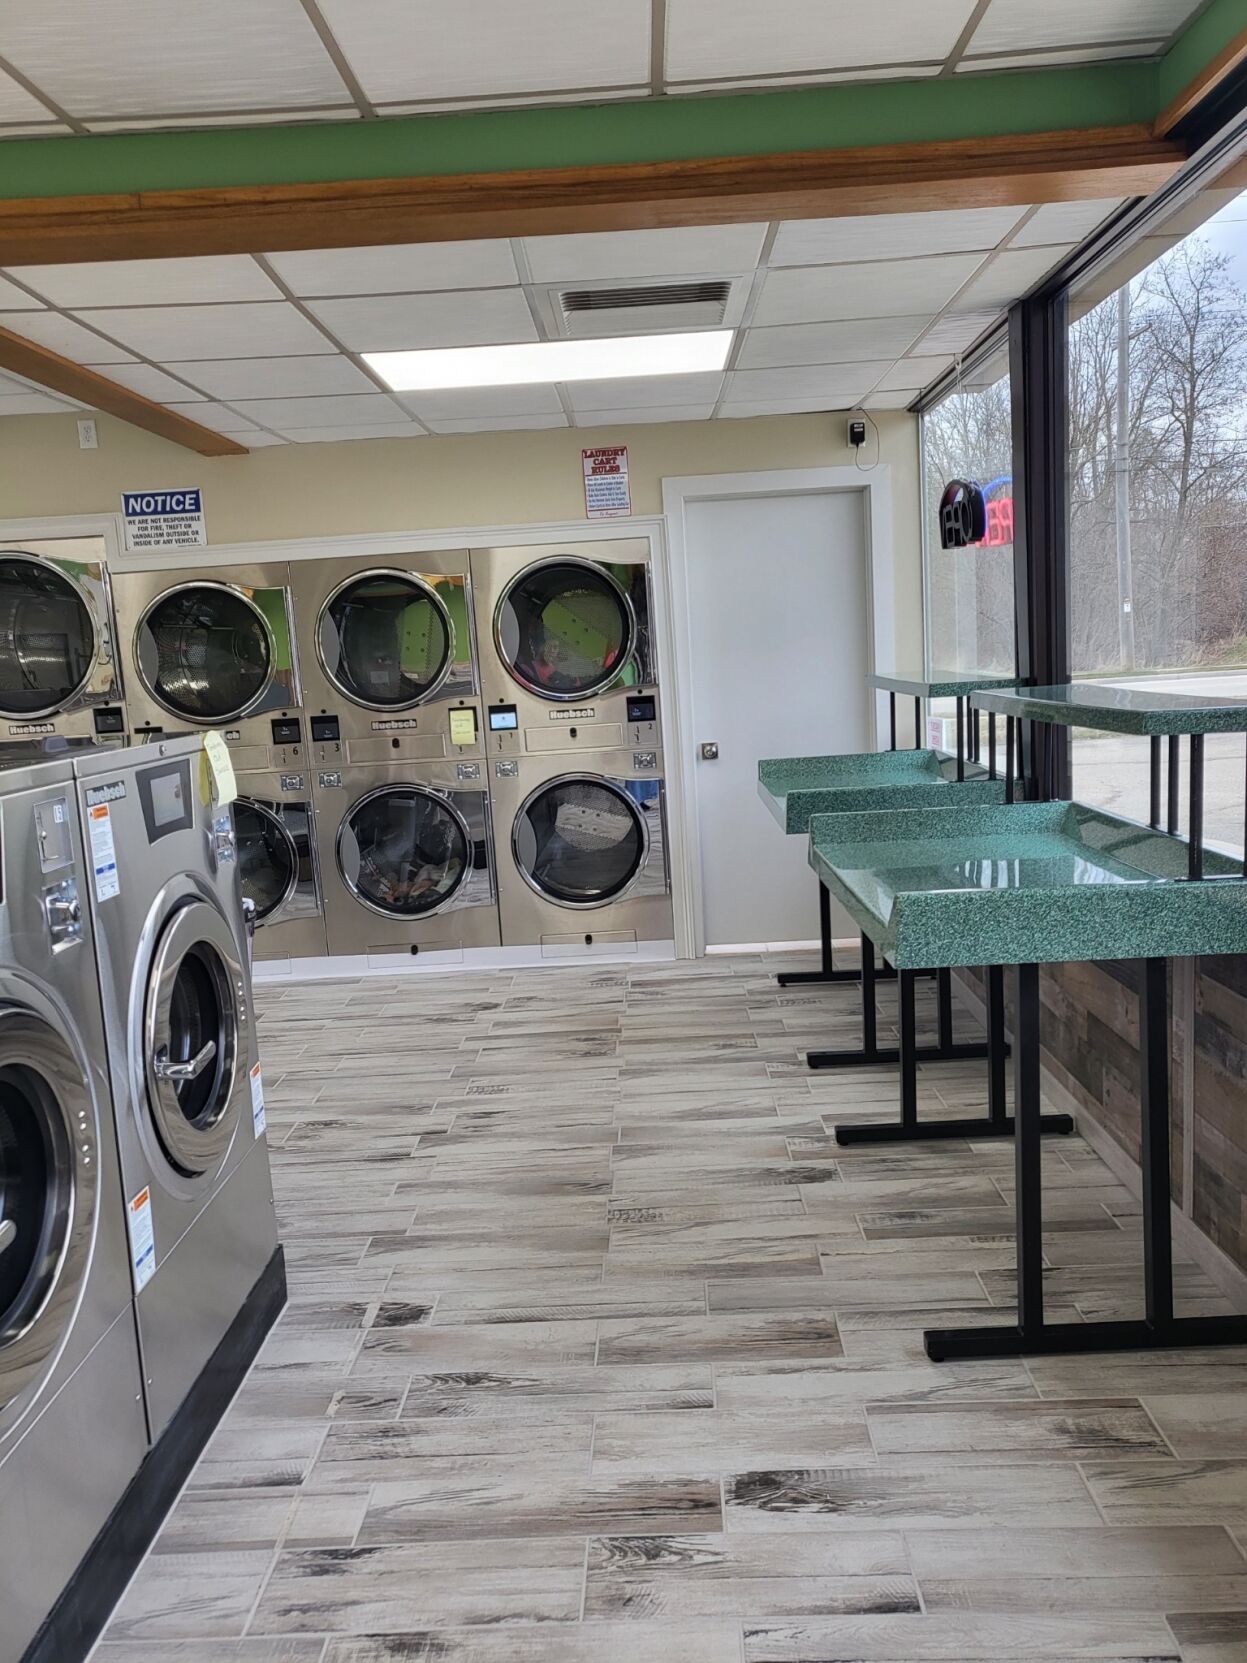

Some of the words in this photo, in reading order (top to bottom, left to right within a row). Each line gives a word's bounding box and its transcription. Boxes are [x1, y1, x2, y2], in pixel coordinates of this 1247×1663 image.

[584, 448, 625, 458] LAUNDRY
[593, 457, 617, 465] CART
[591, 464, 620, 474] RULES
[128, 494, 196, 513] NOTICE
[550, 708, 594, 719] Huebsch
[9, 724, 54, 735] Huebsch
[371, 719, 417, 730] Huebsch
[293, 746, 298, 755] 6
[335, 743, 340, 752] 3
